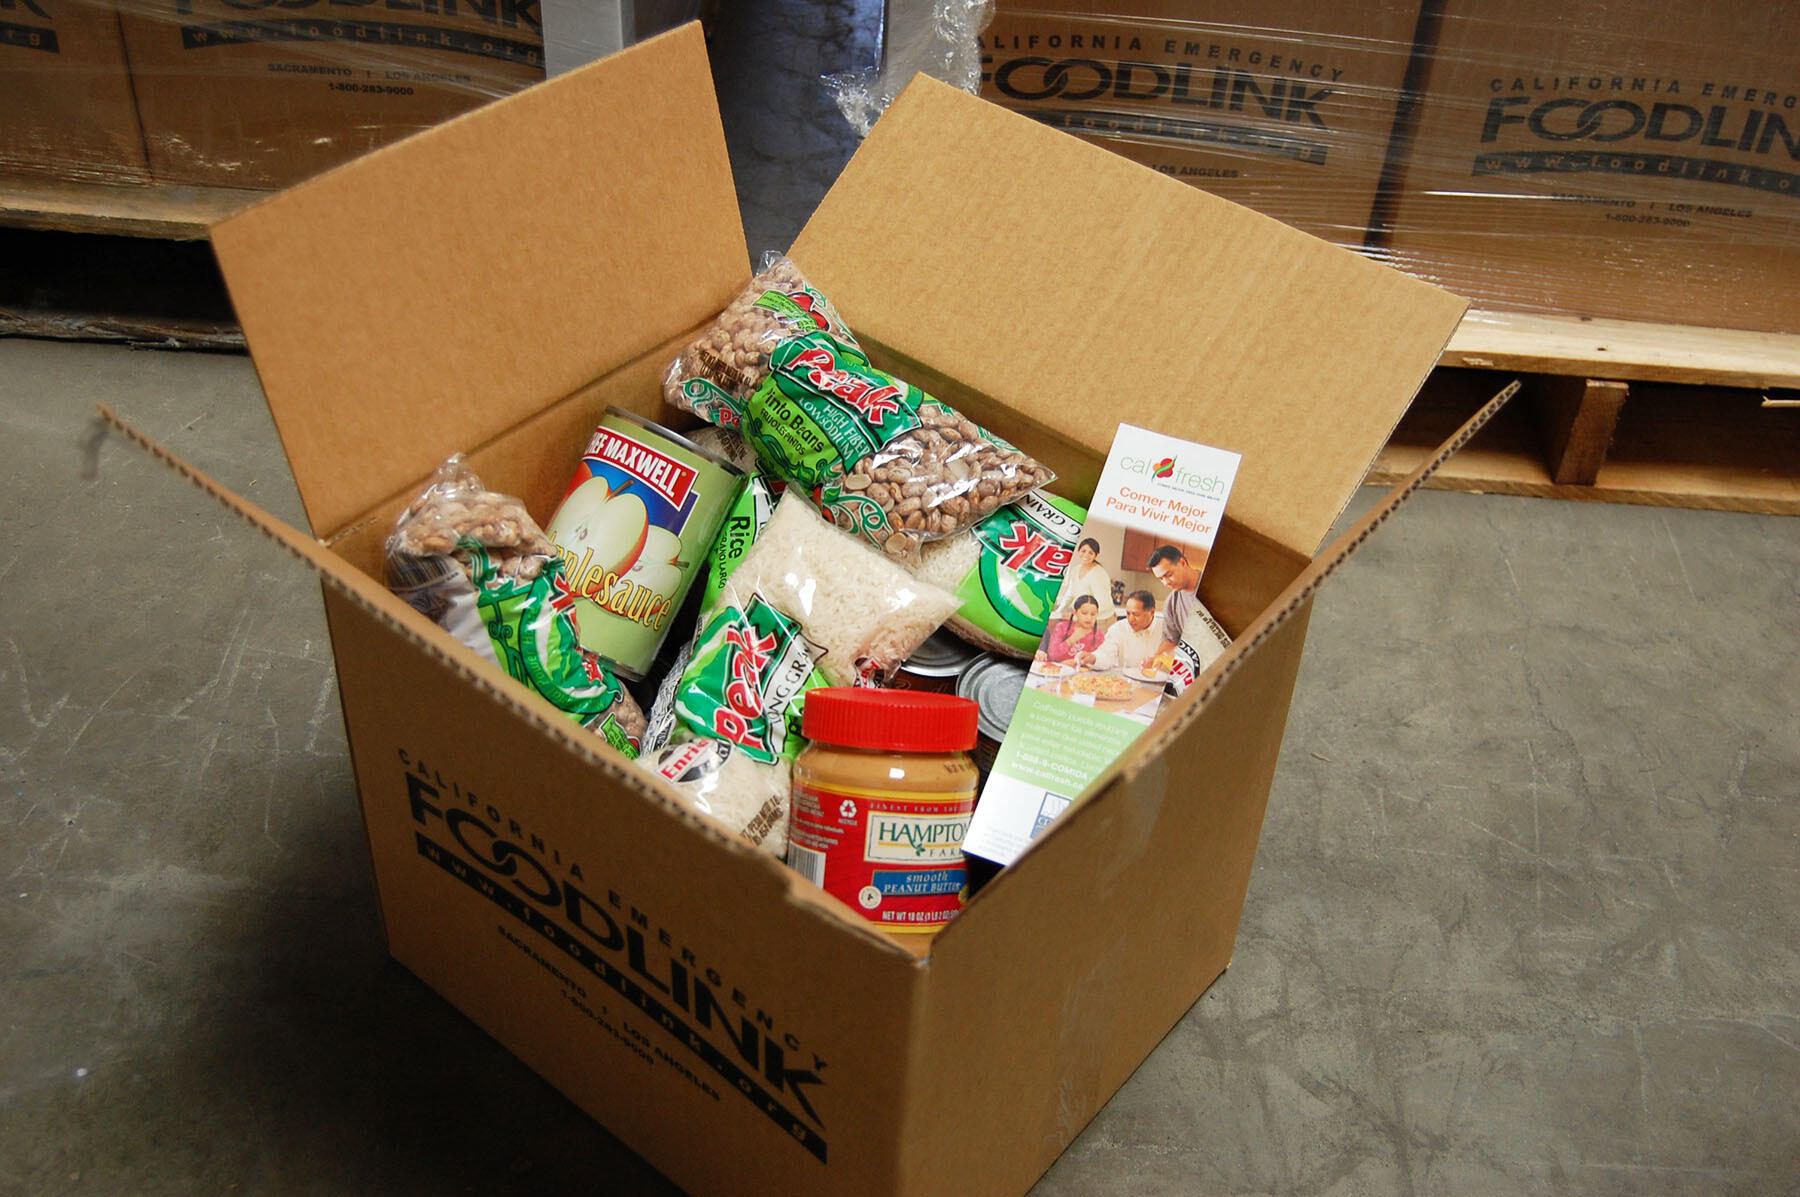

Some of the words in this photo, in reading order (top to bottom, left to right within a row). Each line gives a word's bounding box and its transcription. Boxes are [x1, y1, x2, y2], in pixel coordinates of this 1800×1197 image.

[267, 63, 352, 76] SACRAMENTO
[977, 35, 1141, 50] ALIFORNIA
[1164, 40, 1345, 83] EMERGENCY
[1490, 77, 1680, 94] CALIFORNIA
[1702, 83, 1797, 109] EMERG
[1480, 96, 1800, 162] FOODLIN
[1180, 166, 1239, 178] ANGELES
[1485, 156, 1790, 190] www.foodlink.o
[764, 387, 792, 421] into
[789, 414, 825, 452] Beans
[823, 404, 849, 429] HIGH
[603, 437, 682, 499] MAXWELL
[1106, 496, 1138, 515] Para
[1141, 506, 1171, 523] Vivir
[1172, 515, 1212, 534] Mejor
[1120, 486, 1167, 508] Comer
[1167, 500, 1207, 519] Mejor
[728, 516, 751, 560] Rice
[550, 531, 673, 632] plesauce
[660, 738, 708, 781] Enric
[883, 883, 929, 894] PEANUT
[906, 871, 948, 883] smooth
[398, 748, 584, 881] CALIFORNIA
[609, 889, 828, 1072] EMERGENCY
[882, 910, 895, 920] NET
[896, 911, 906, 920] WT
[406, 771, 825, 1130] FOODLINK
[424, 843, 807, 1142] www.foodlink.org
